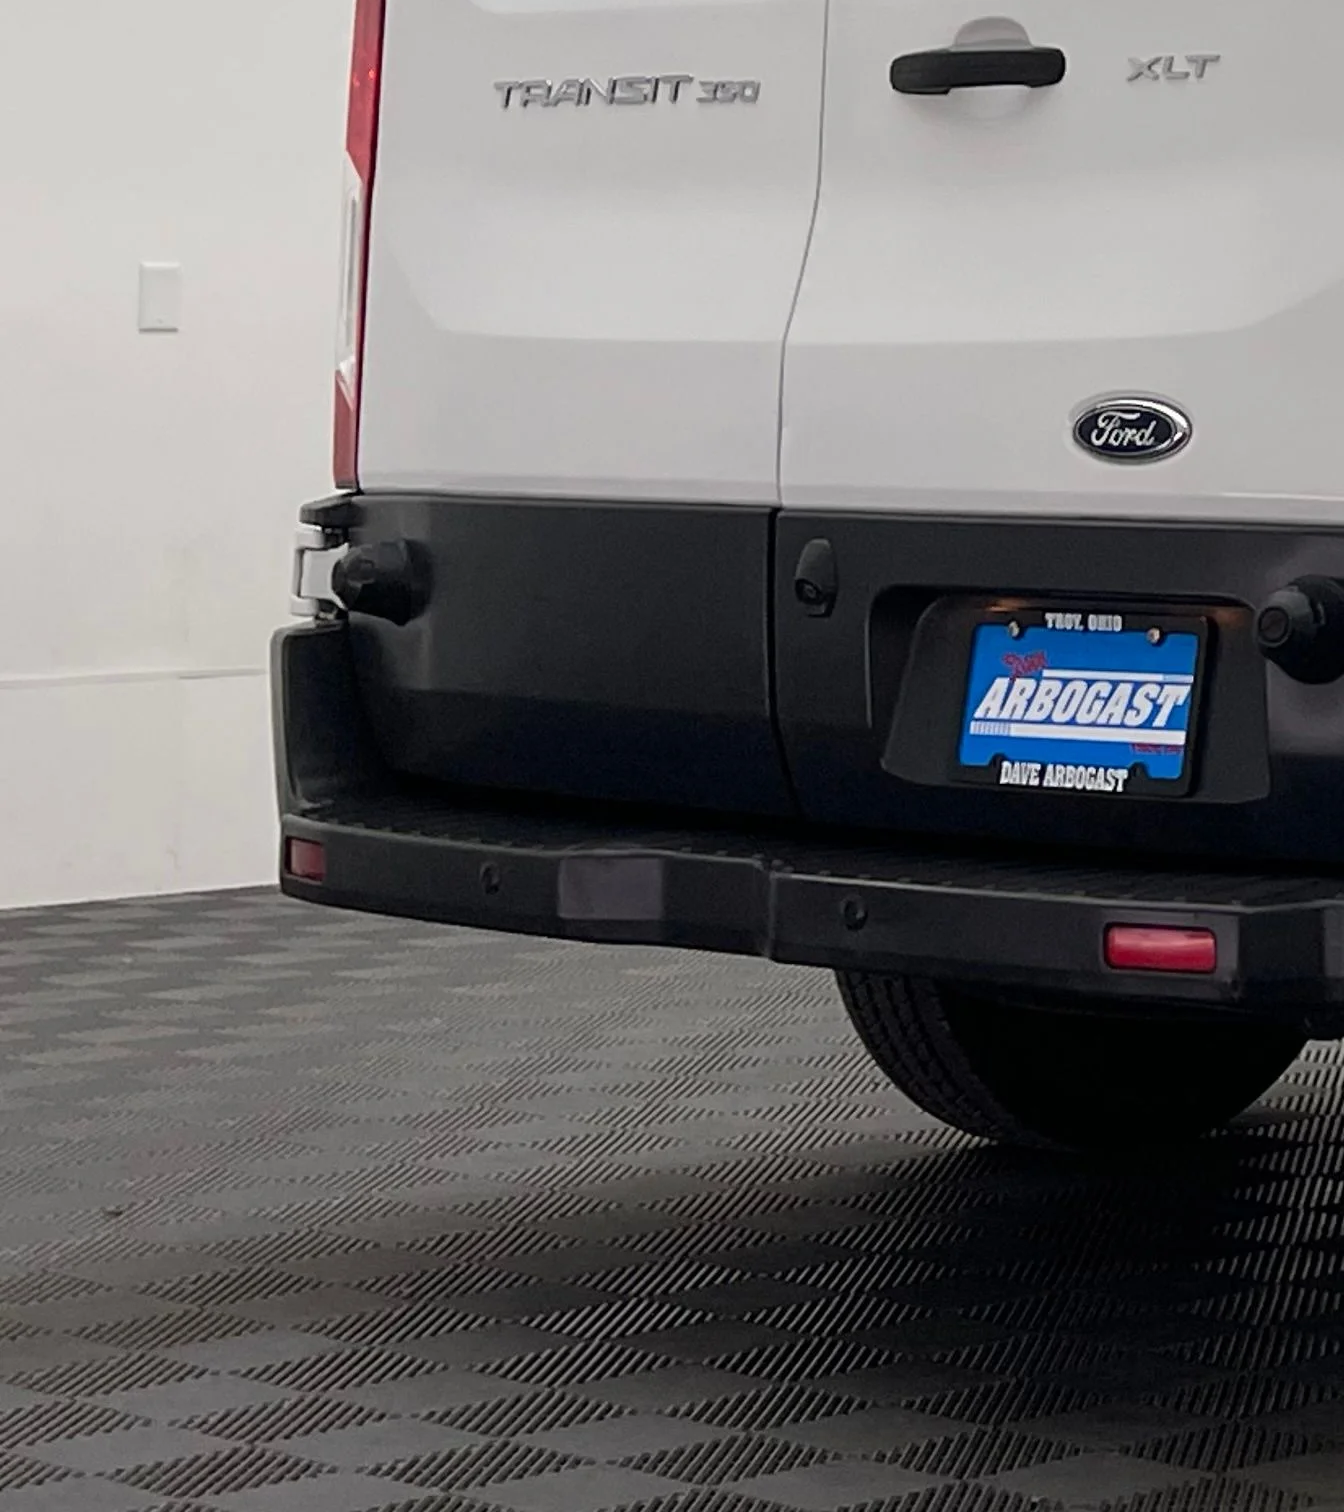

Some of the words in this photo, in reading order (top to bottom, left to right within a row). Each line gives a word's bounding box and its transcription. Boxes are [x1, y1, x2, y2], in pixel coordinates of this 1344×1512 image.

[1126, 54, 1221, 82] XLT
[494, 74, 694, 108] TRANSIT
[696, 80, 761, 103] 350
[1091, 411, 1157, 446] Ford
[1088, 614, 1123, 632] OHIO
[974, 677, 1192, 727] ARBOGAST
[1000, 760, 1041, 786] DAVE
[1043, 763, 1129, 793] ARBOGAST
